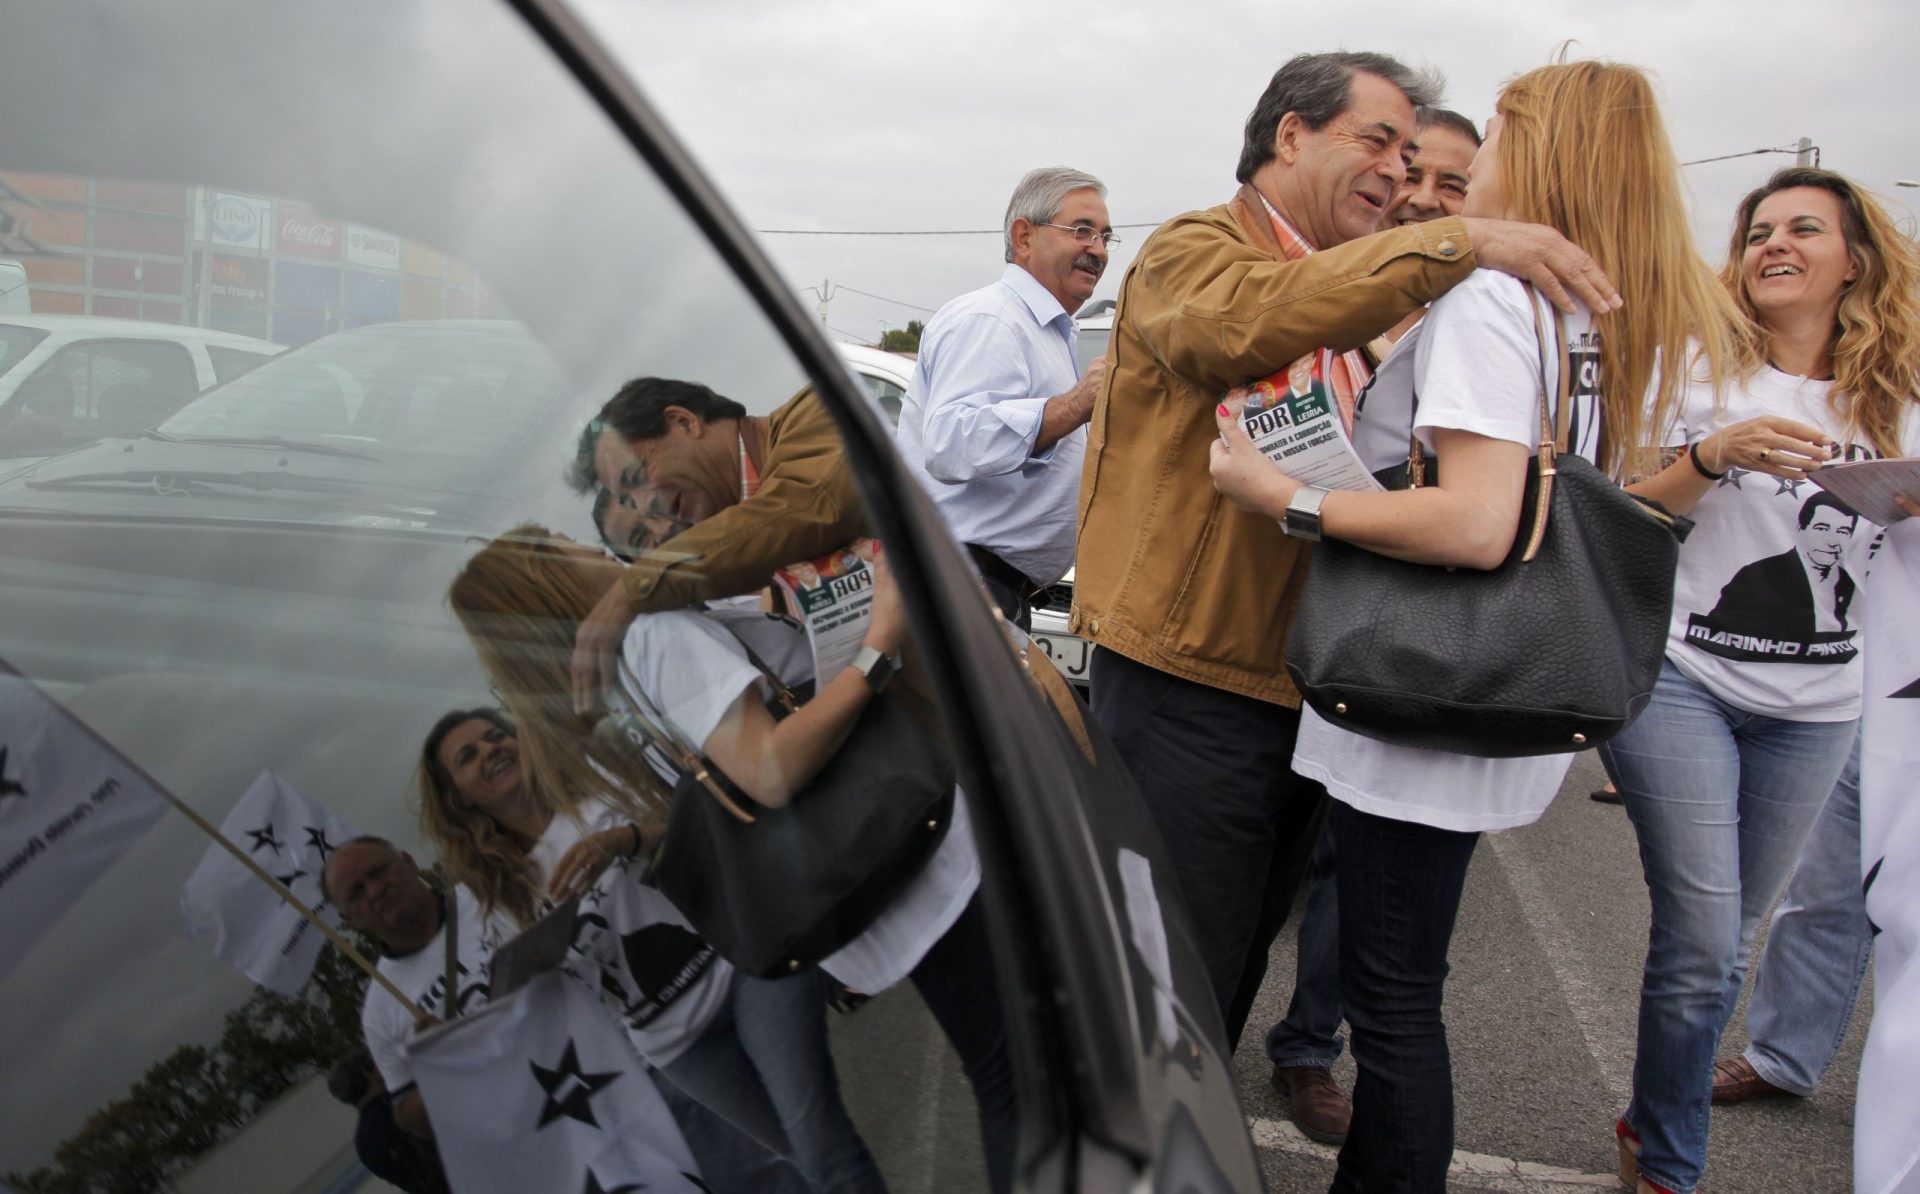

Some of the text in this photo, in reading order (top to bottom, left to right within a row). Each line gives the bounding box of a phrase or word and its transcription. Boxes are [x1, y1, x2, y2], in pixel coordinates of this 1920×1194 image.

[1245, 406, 1290, 440] PDR
[1297, 406, 1324, 422] LEIRIA
[1288, 435, 1295, 443] A
[1294, 420, 1332, 441] CORRUPÇÃO
[1273, 452, 1283, 462] AS
[1282, 443, 1308, 457] NOSSAS
[1784, 478, 1793, 490] S
[1689, 624, 1854, 657] MARINHO PINTO
